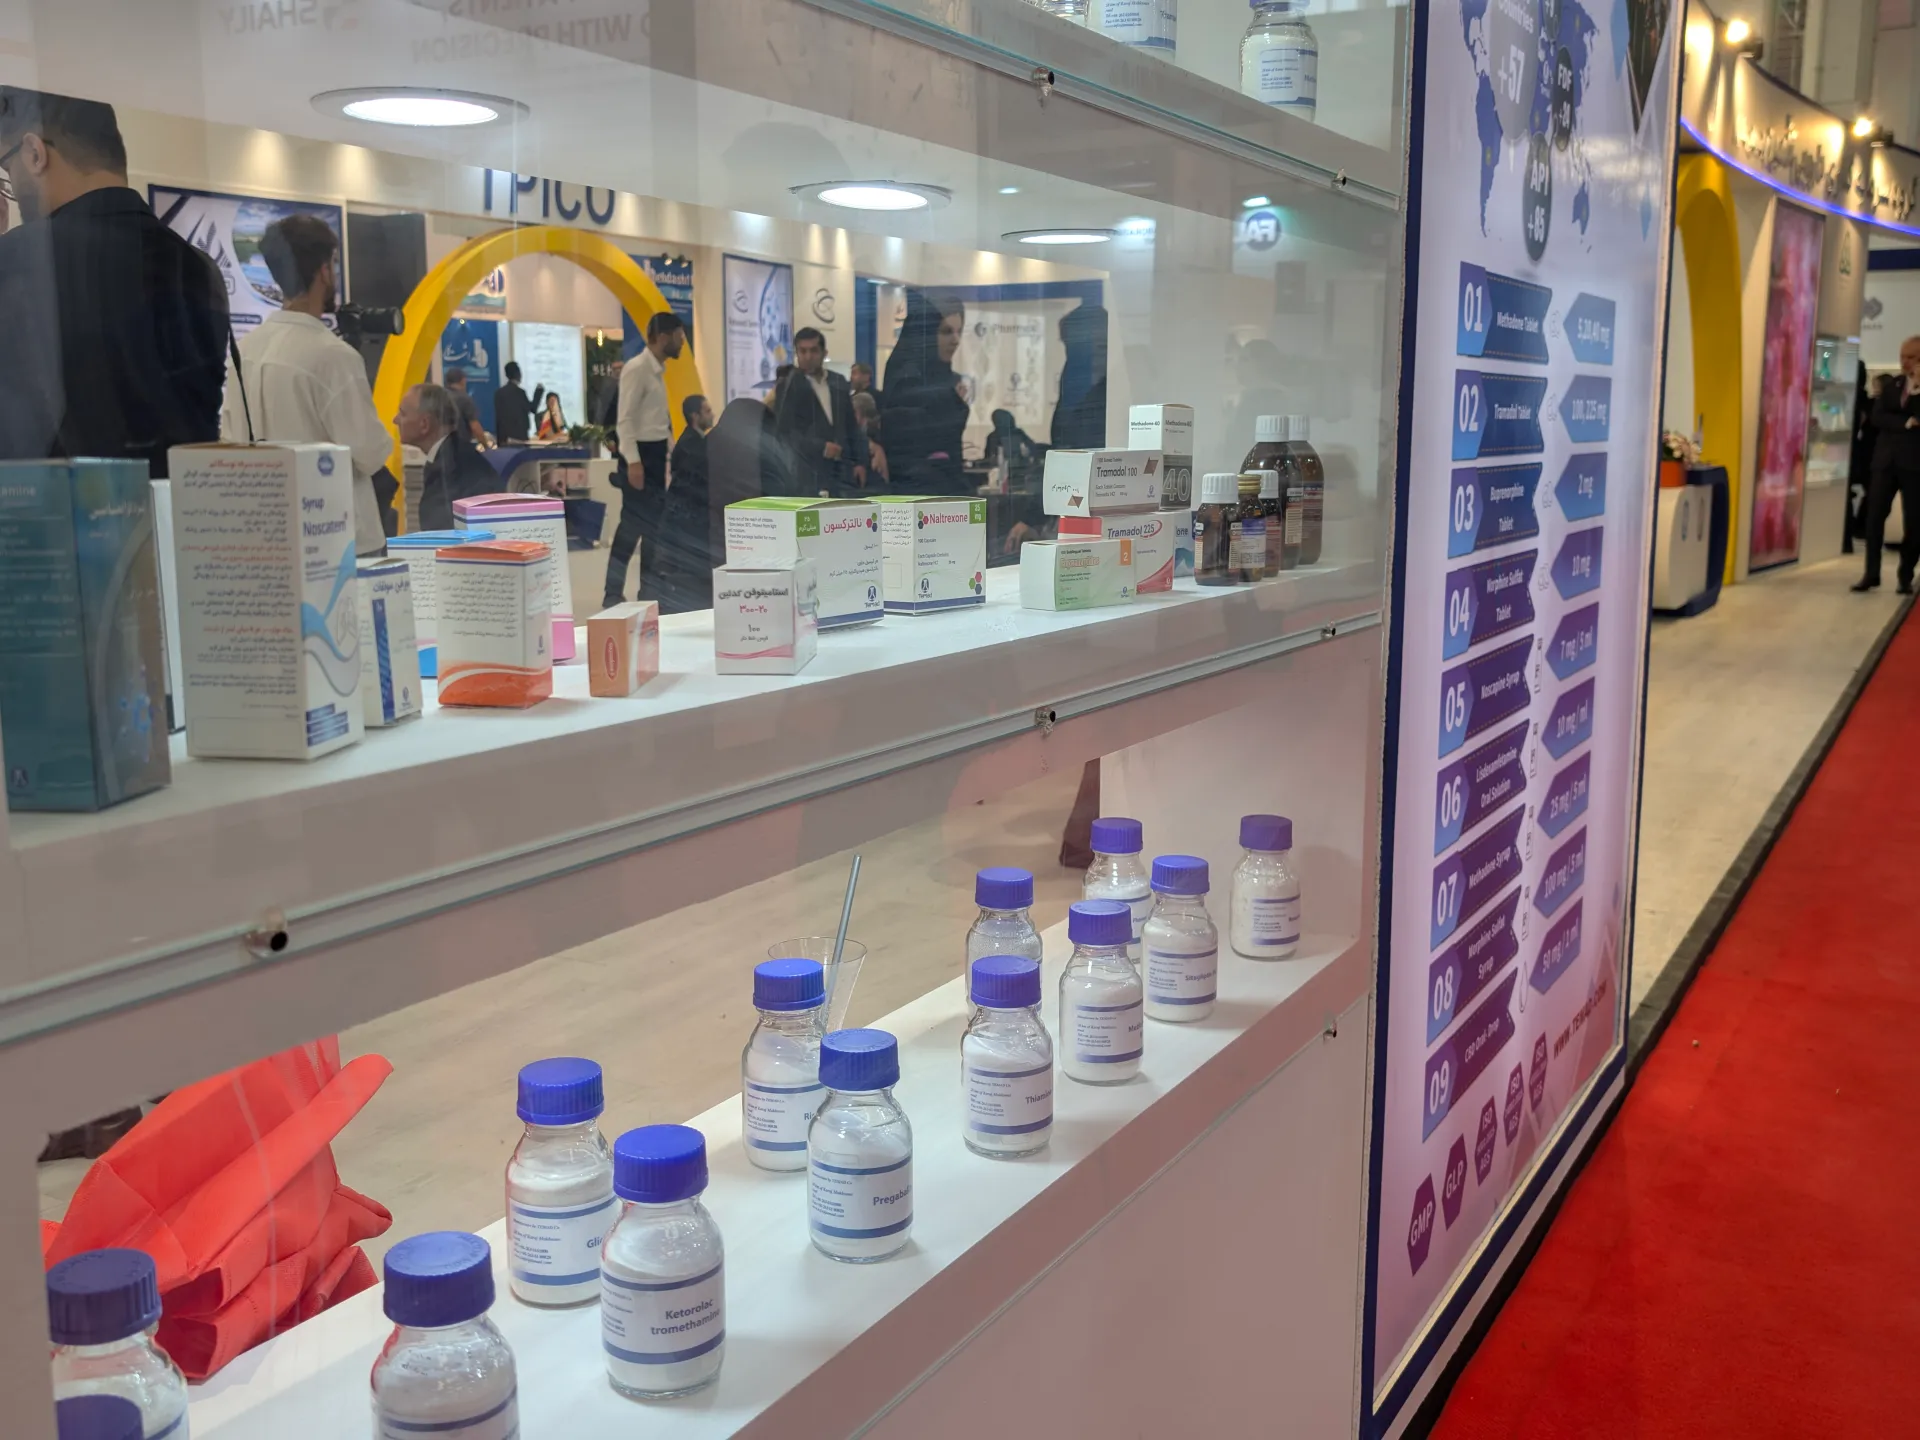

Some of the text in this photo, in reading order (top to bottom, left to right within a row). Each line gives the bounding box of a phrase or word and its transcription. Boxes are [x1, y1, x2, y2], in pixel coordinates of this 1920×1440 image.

[1497, 44, 1525, 105] +57
[1558, 63, 1572, 92] FDF
[1531, 160, 1549, 196] API
[1464, 282, 1483, 333] 01
[1459, 384, 1479, 433] 02
[1096, 465, 1138, 478] Tramadol 100
[1162, 468, 1191, 502] 40
[302, 496, 325, 514] Syrup
[823, 517, 862, 534] نالترکسون
[929, 513, 968, 524] Naltrexone
[1454, 484, 1475, 533] 03
[1107, 523, 1155, 540] Tramadol 225
[1123, 552, 1128, 562] 2
[1449, 586, 1469, 638] 04
[1445, 681, 1464, 733] 05
[1441, 775, 1460, 828] 06
[1437, 871, 1458, 928] 07
[1433, 965, 1453, 1020] 08
[1430, 1059, 1449, 1115] 09
[1445, 1164, 1464, 1196] GLP
[1410, 1201, 1433, 1247] GMP
[665, 1298, 714, 1321] Ketorolac
